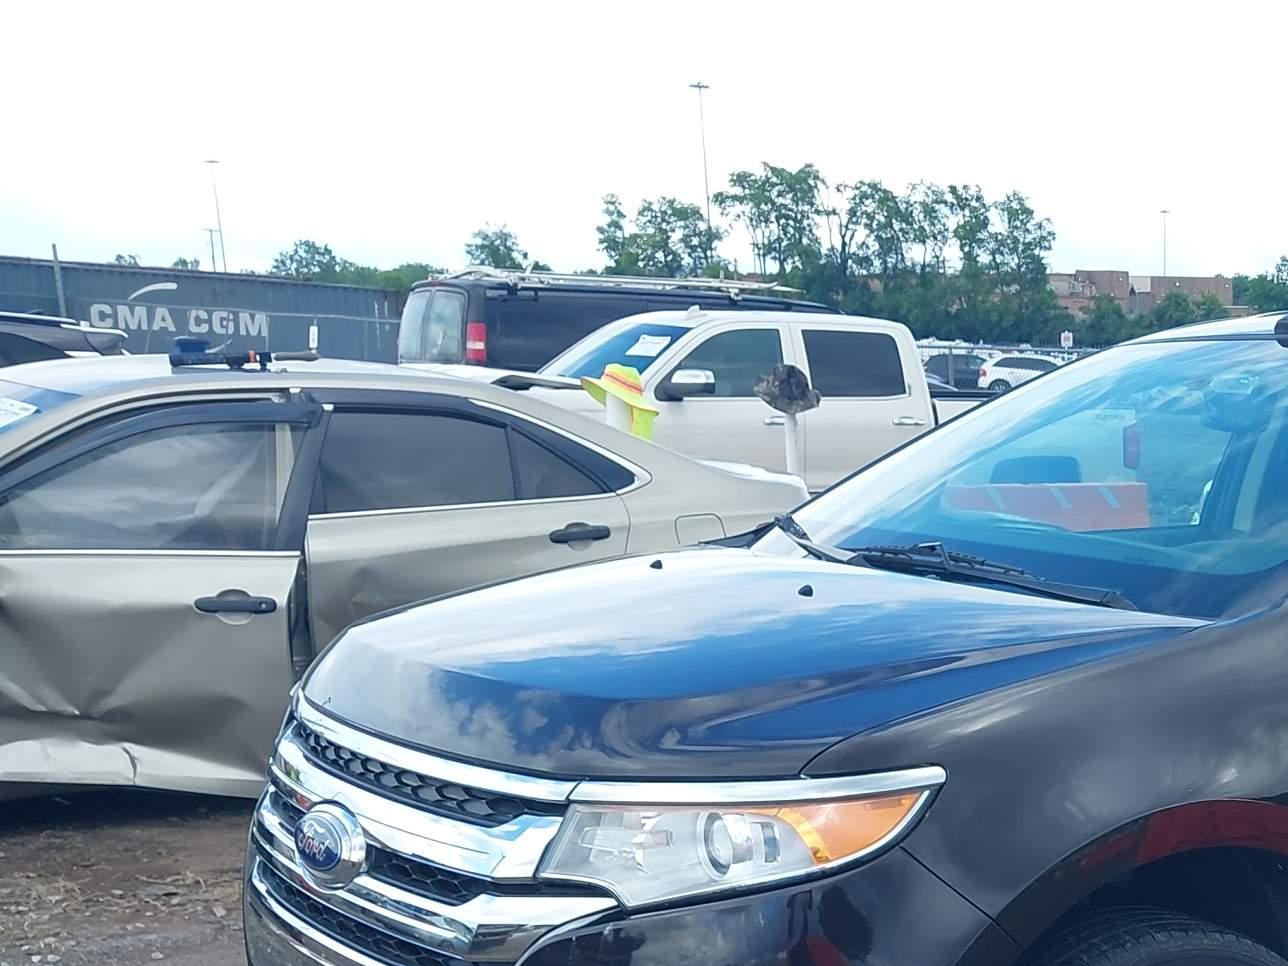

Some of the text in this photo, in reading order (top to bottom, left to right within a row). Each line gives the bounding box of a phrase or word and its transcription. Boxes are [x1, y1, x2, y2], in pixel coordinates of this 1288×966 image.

[90, 303, 267, 337] CMA CGM
[298, 820, 331, 861] Ford
